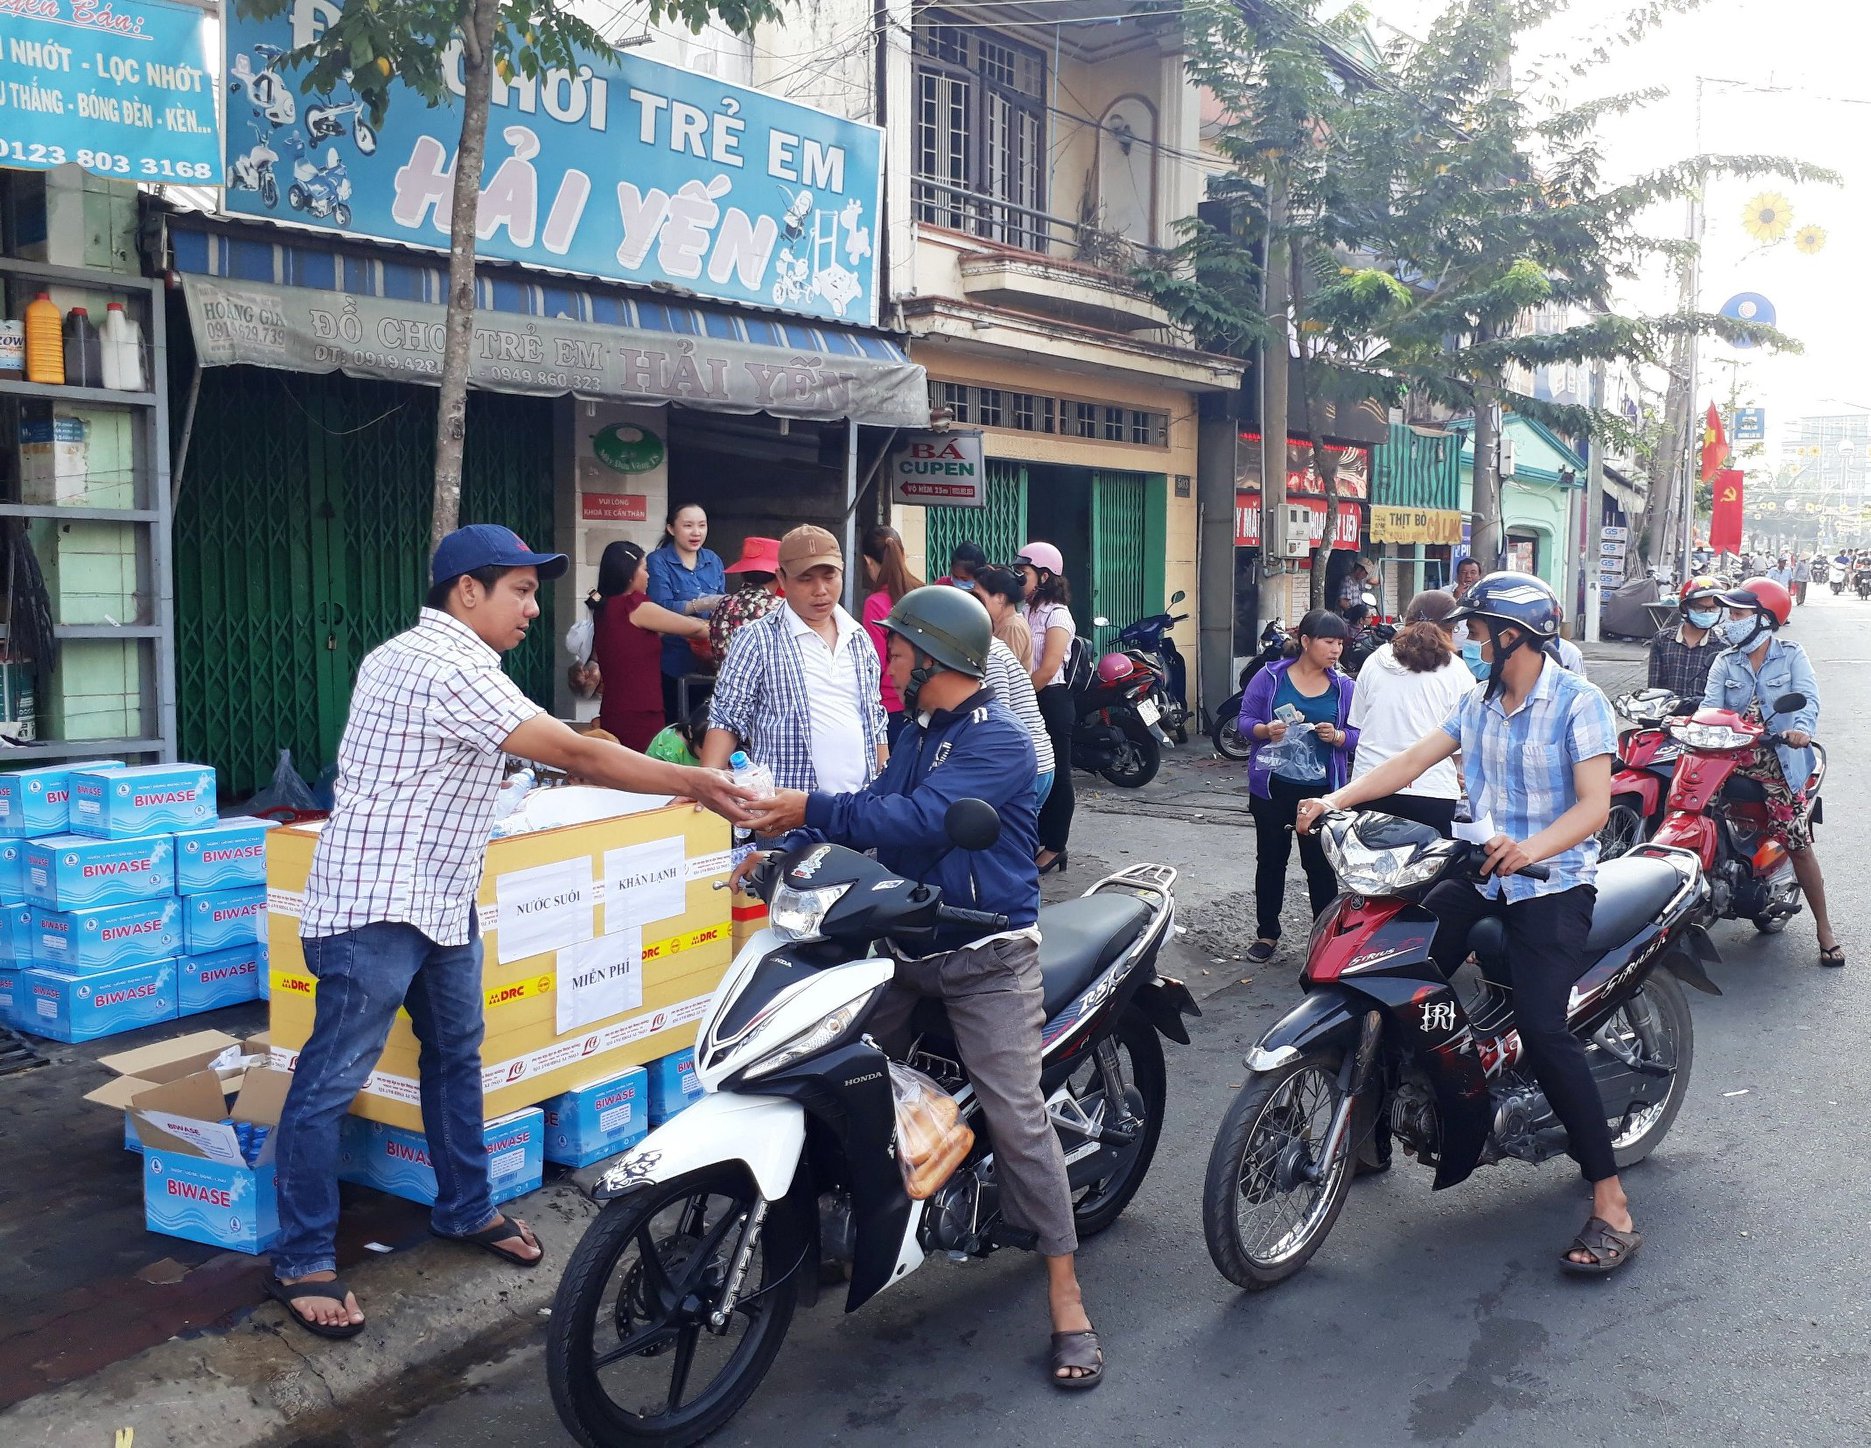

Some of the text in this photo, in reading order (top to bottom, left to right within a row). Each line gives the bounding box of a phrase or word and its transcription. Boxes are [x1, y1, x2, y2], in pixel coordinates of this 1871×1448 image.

[10, 38, 72, 72] NHỚT
[97, 53, 140, 86] LỌC
[146, 62, 203, 92] NHỚT
[122, 95, 153, 128] ĐÈN
[630, 96, 746, 169] TRẺ
[767, 127, 846, 194] EM
[76, 149, 130, 173] 803
[140, 157, 212, 179] 3168
[392, 126, 778, 291] HẢI YẾN
[310, 296, 362, 344] ĐỒ
[475, 323, 544, 364] TRẺ
[554, 338, 603, 370] EM
[619, 339, 729, 400] HẢI
[745, 356, 856, 411] YẾN
[910, 438, 966, 459] BÁ
[900, 461, 975, 476] CUPEN
[1389, 512, 1411, 529] THỊT
[134, 790, 196, 808] BIWASE
[203, 845, 263, 863] BIWASE
[83, 859, 151, 878] BIWASE
[650, 867, 677, 884] LẠNH
[516, 897, 551, 917] NƯỚC
[102, 919, 163, 942] BIWASE
[700, 929, 718, 942] DRC
[641, 946, 660, 960] DRC
[200, 961, 257, 983] BIWASE
[609, 957, 631, 978] PHÍ
[95, 983, 157, 1008] BIWASE
[291, 979, 311, 992] DRC
[500, 986, 524, 1000] DRC
[844, 1071, 883, 1087] HONDA
[595, 1088, 635, 1110] BIWASE
[487, 1132, 531, 1155] BIWASE
[167, 1178, 231, 1208] BIWASE
